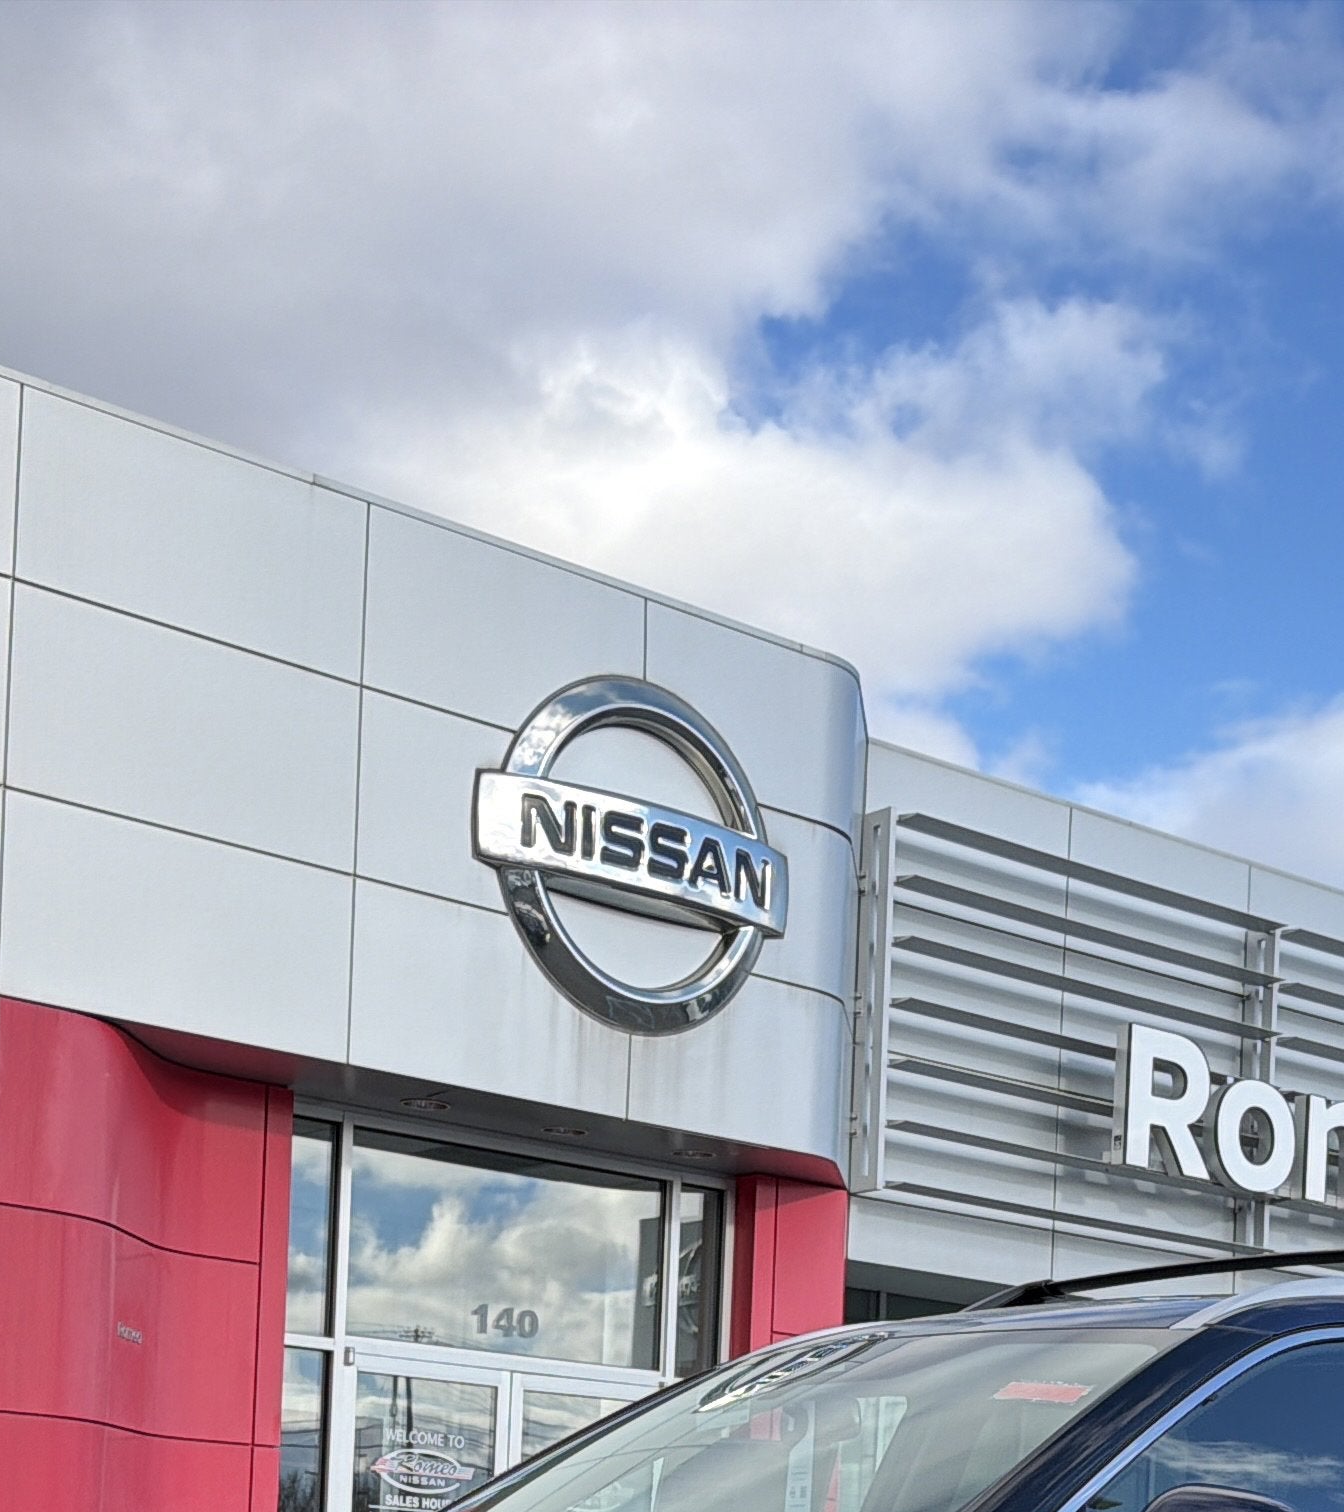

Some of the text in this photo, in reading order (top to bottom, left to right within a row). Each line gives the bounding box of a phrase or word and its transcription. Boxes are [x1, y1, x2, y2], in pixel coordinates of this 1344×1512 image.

[519, 791, 773, 912] NISSAN
[471, 1303, 540, 1339] 140
[383, 1427, 465, 1449] WELCOME TO
[392, 1453, 458, 1476] Romeo
[399, 1474, 446, 1488] NISSAN
[384, 1493, 420, 1508] SALES
